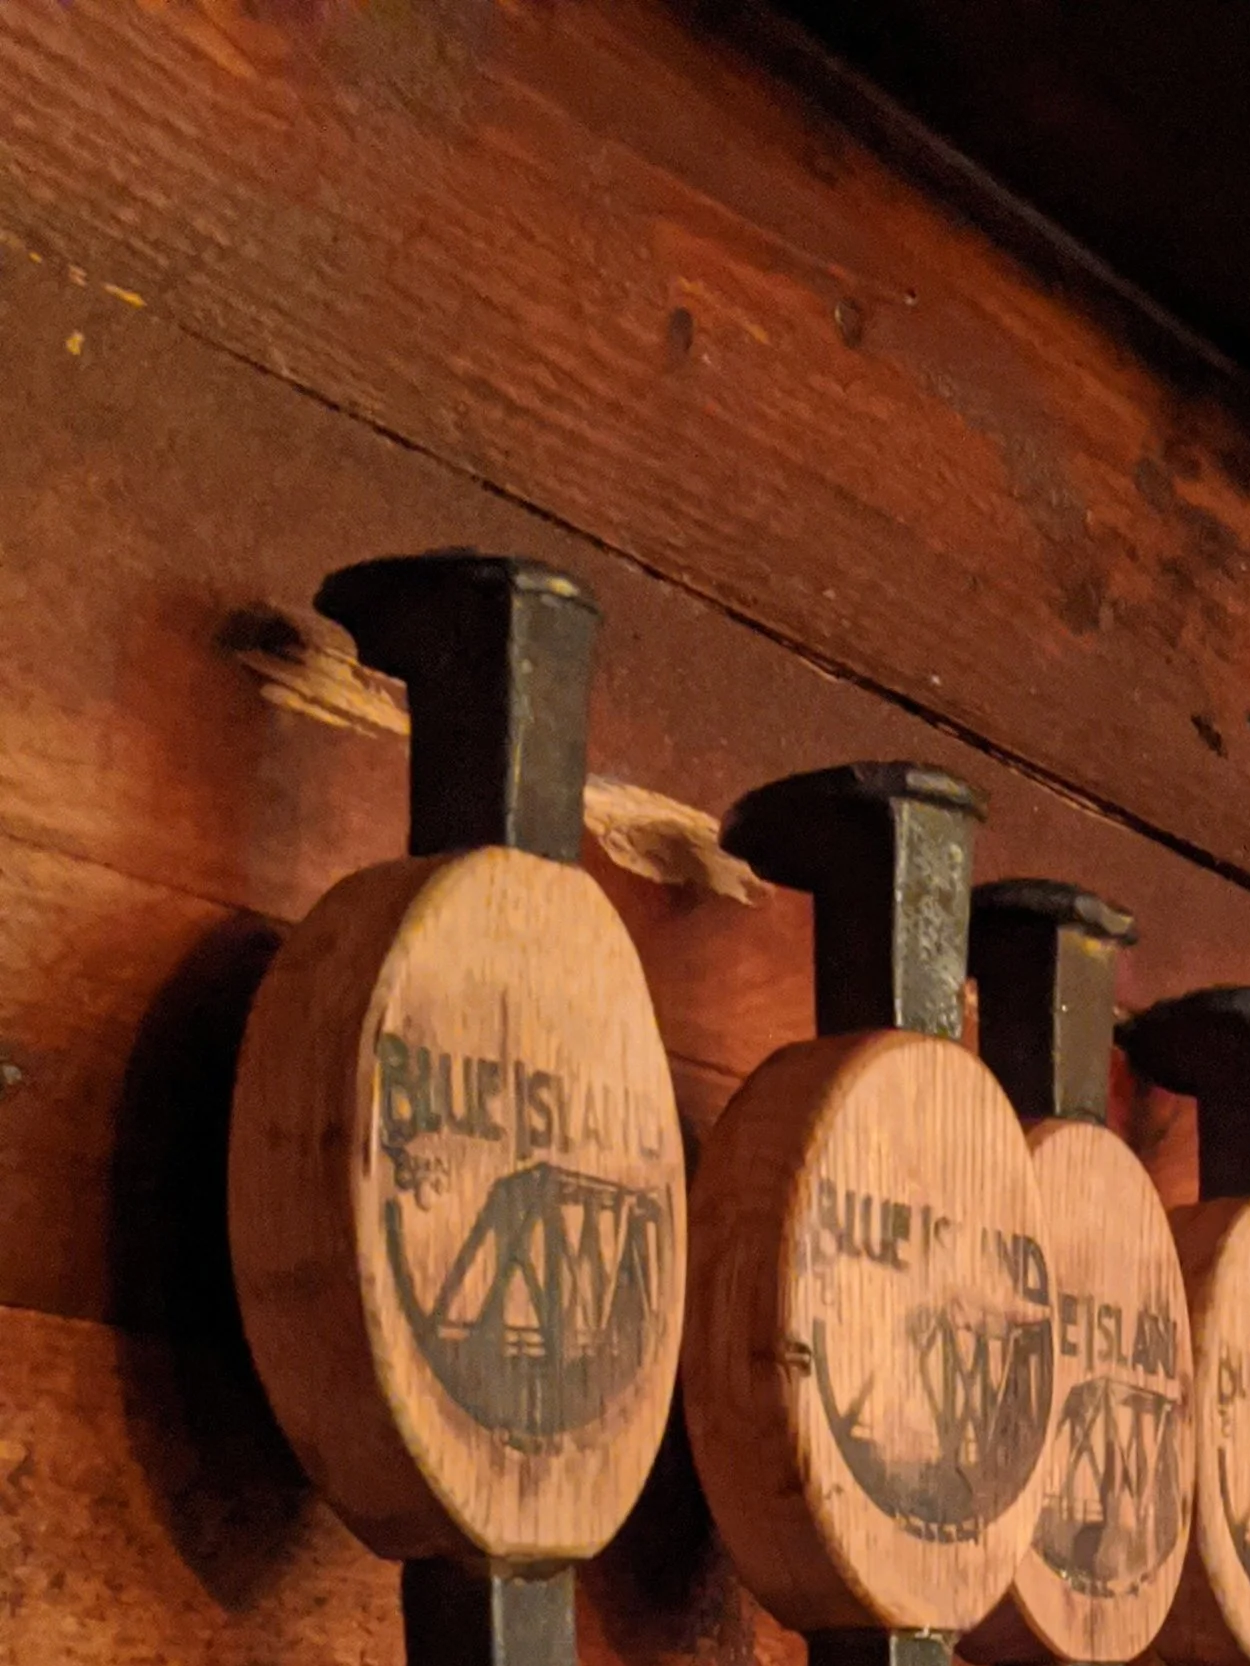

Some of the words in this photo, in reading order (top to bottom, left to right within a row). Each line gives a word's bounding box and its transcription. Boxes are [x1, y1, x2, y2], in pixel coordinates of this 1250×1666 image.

[377, 1032, 504, 1144] BLUE
[921, 1204, 1050, 1306] ISND
[1085, 1293, 1177, 1380] ISLAN
